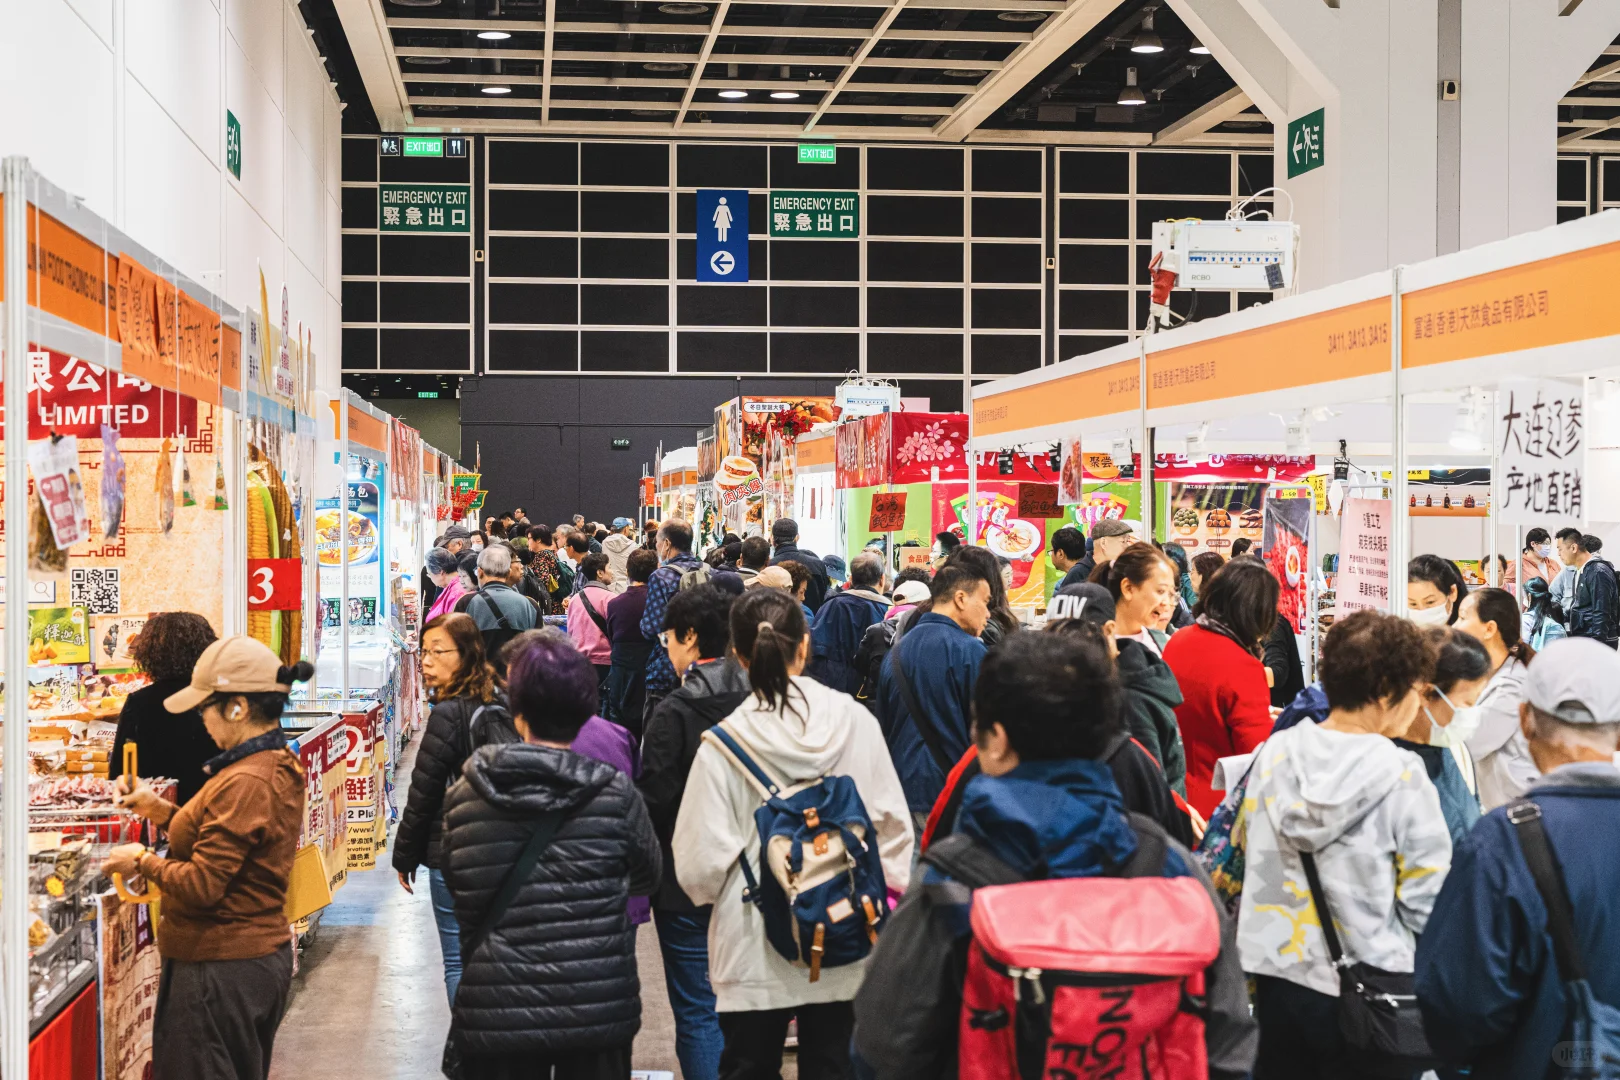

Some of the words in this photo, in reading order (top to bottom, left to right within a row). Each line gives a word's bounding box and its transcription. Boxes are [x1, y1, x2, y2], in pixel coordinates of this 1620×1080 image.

[406, 142, 426, 152] EXIT
[800, 149, 820, 158] EXIT
[382, 191, 444, 204] EMERGENCY
[445, 192, 468, 204] EXIT
[773, 197, 832, 210] EMERGENCY
[834, 198, 855, 211] EXIT
[383, 206, 466, 226] 緊急出口
[773, 213, 854, 232] 緊急出口
[41, 404, 150, 427] LIMITED
[1502, 389, 1583, 460] 大连辽参
[1503, 464, 1583, 519] 产地直销
[249, 566, 275, 604] 3
